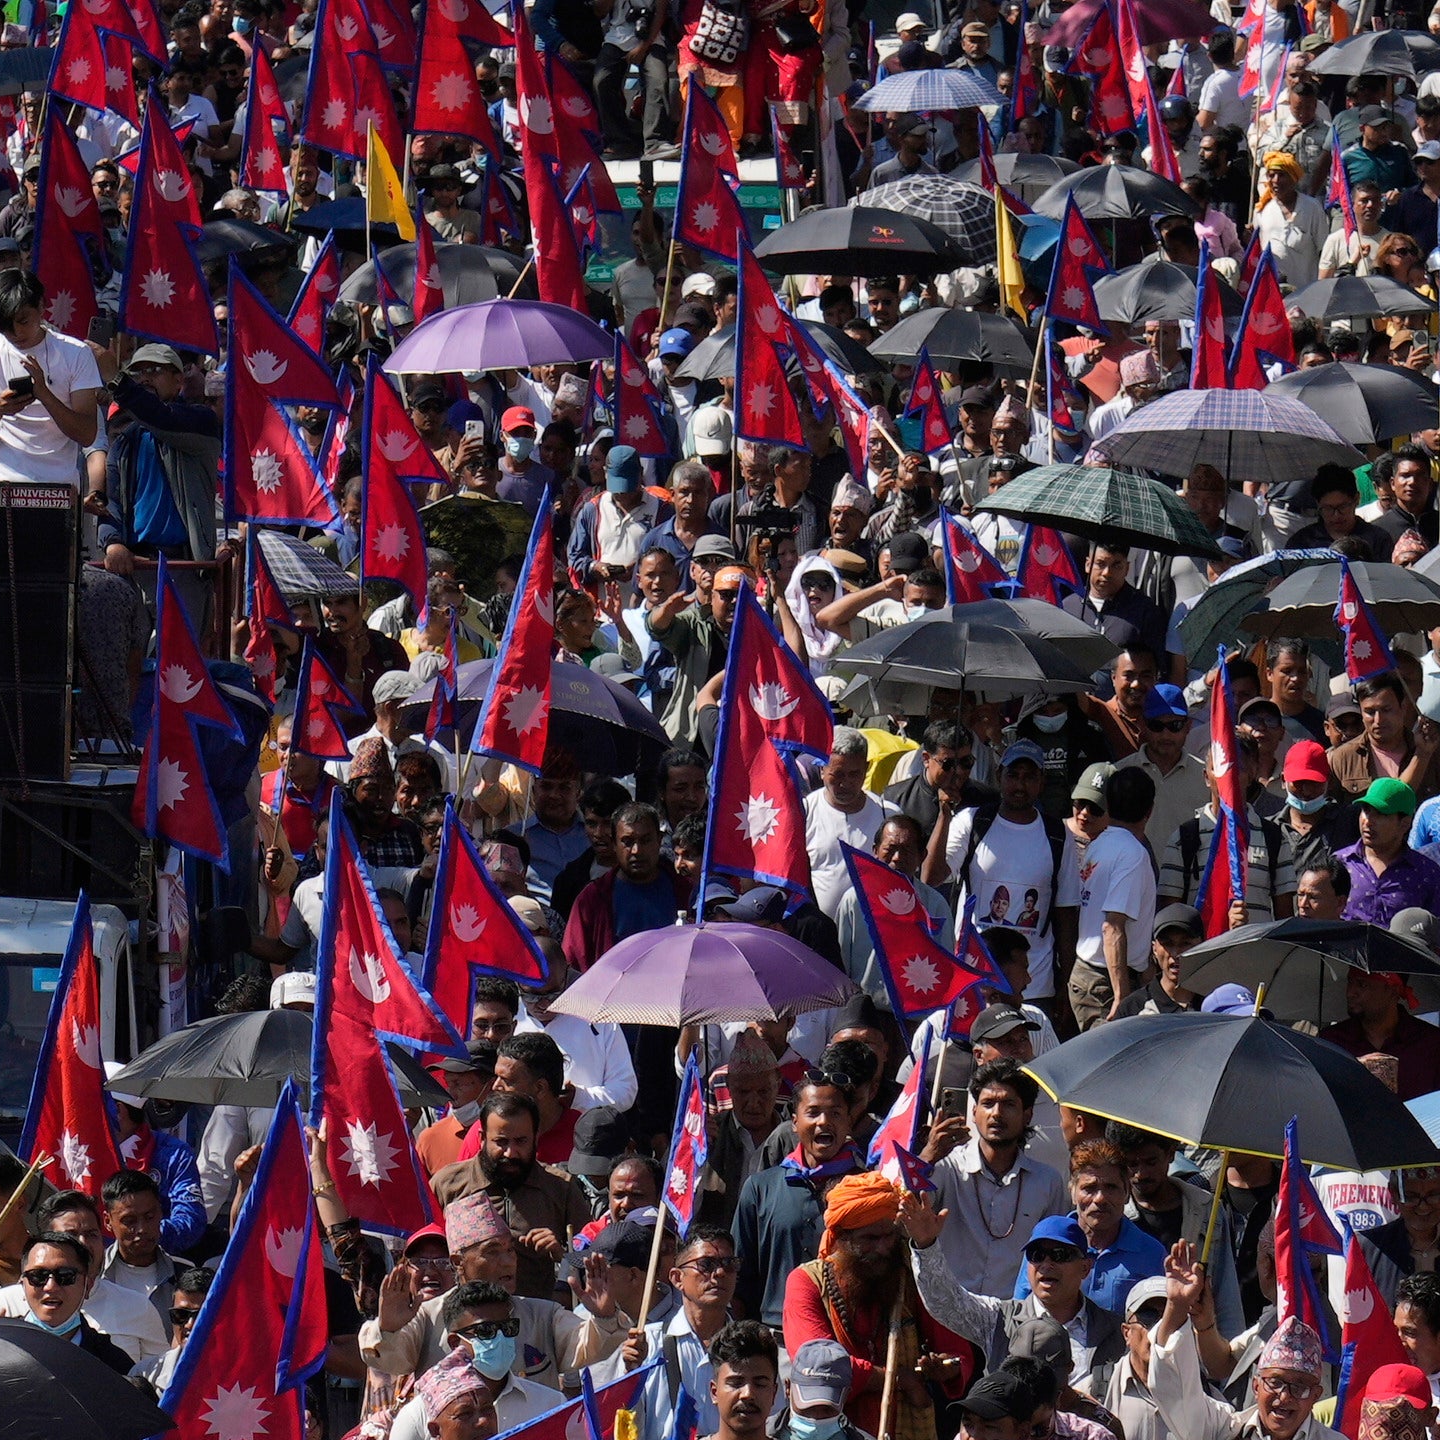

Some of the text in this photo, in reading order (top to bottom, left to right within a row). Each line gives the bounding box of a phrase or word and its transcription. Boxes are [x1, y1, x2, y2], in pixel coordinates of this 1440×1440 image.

[12, 488, 71, 499] UNIVERSAL
[2, 498, 26, 507] SUND
[1091, 771, 1104, 789] LA
[1349, 1212, 1376, 1227] 1983
